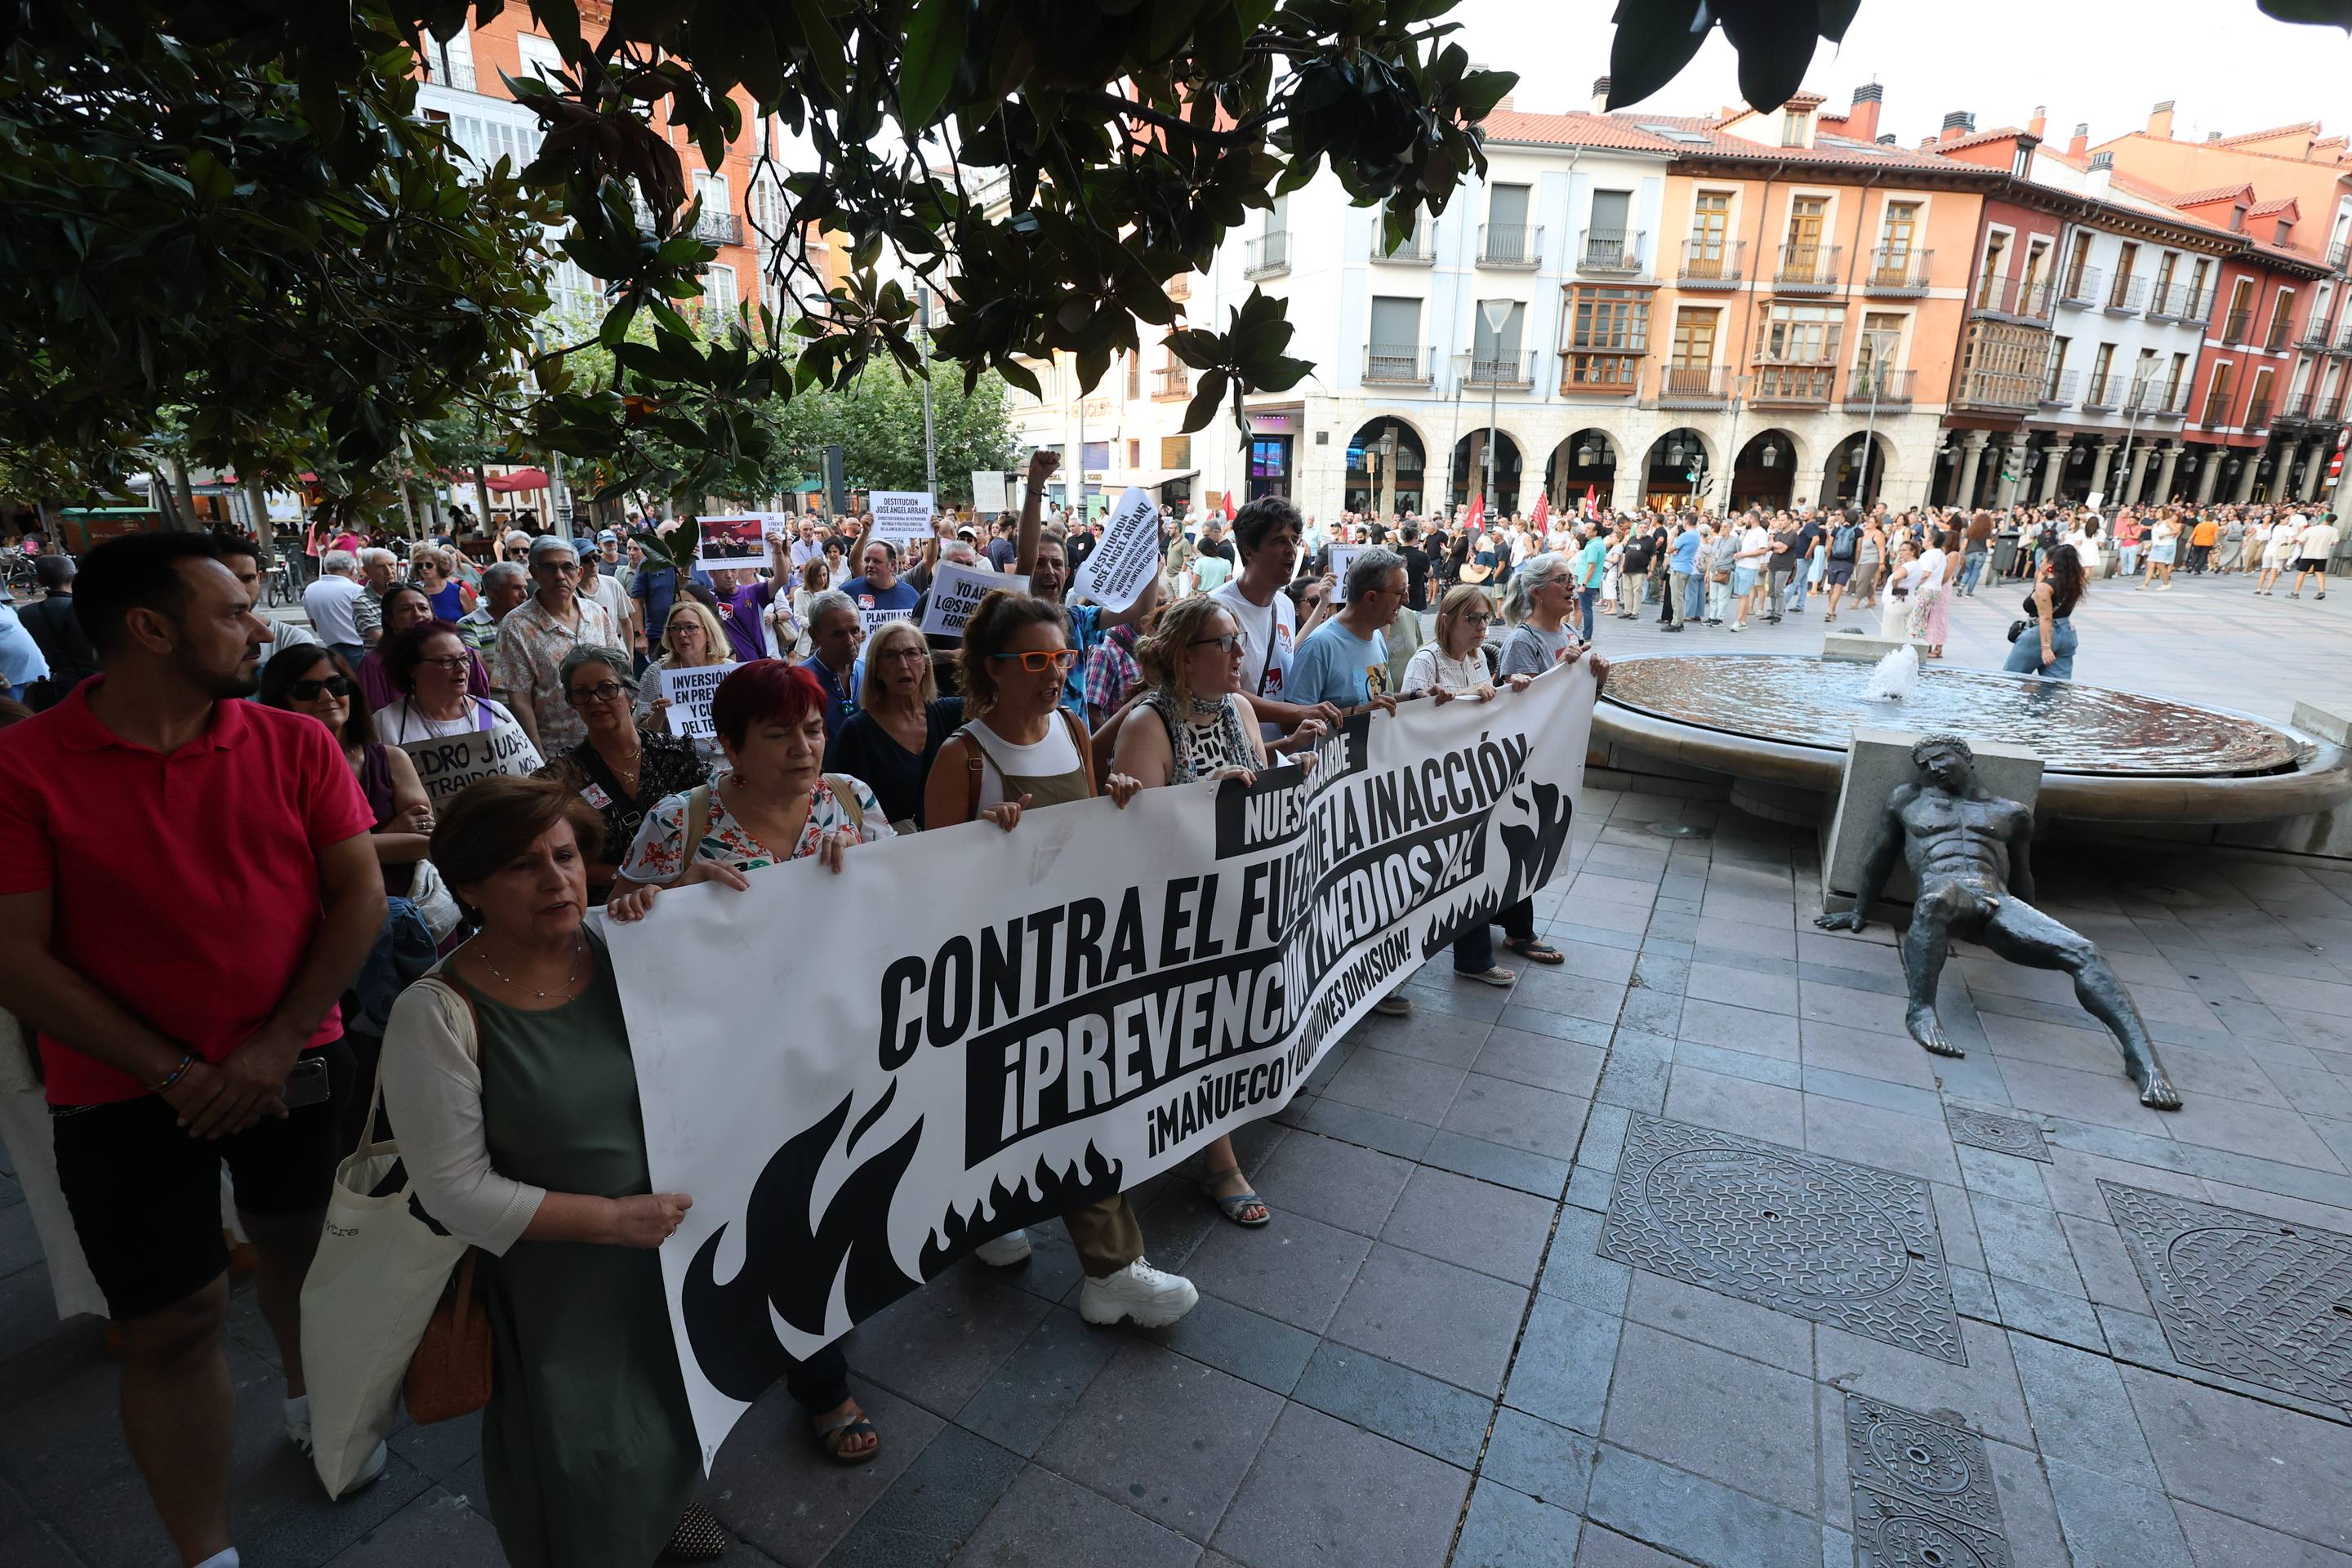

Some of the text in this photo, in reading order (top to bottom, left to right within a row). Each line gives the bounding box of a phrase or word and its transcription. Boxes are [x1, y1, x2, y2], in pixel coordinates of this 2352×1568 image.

[907, 506, 929, 514] ARRANZ
[1126, 501, 1152, 541] ARRANZ
[1089, 514, 1129, 574] DESTITUCION
[1116, 568, 1132, 593] NATURAL
[1130, 568, 1143, 586] JUNTA
[956, 581, 972, 598] YO
[934, 595, 963, 613] L@S
[675, 690, 689, 704] EN
[689, 705, 697, 718] Y
[681, 719, 702, 735] DEL
[879, 885, 1147, 1071] CONTRA
[1159, 872, 1223, 969] EL
[1329, 785, 1365, 866] LA
[1000, 920, 1312, 1142] ¡PREVENCIÓN
[1312, 902, 1321, 980] Y
[1319, 844, 1433, 967] MEDIOS
[1148, 926, 1412, 1158] ¡MAÑUECO Y QUIÑONES DIMISIÓN!
